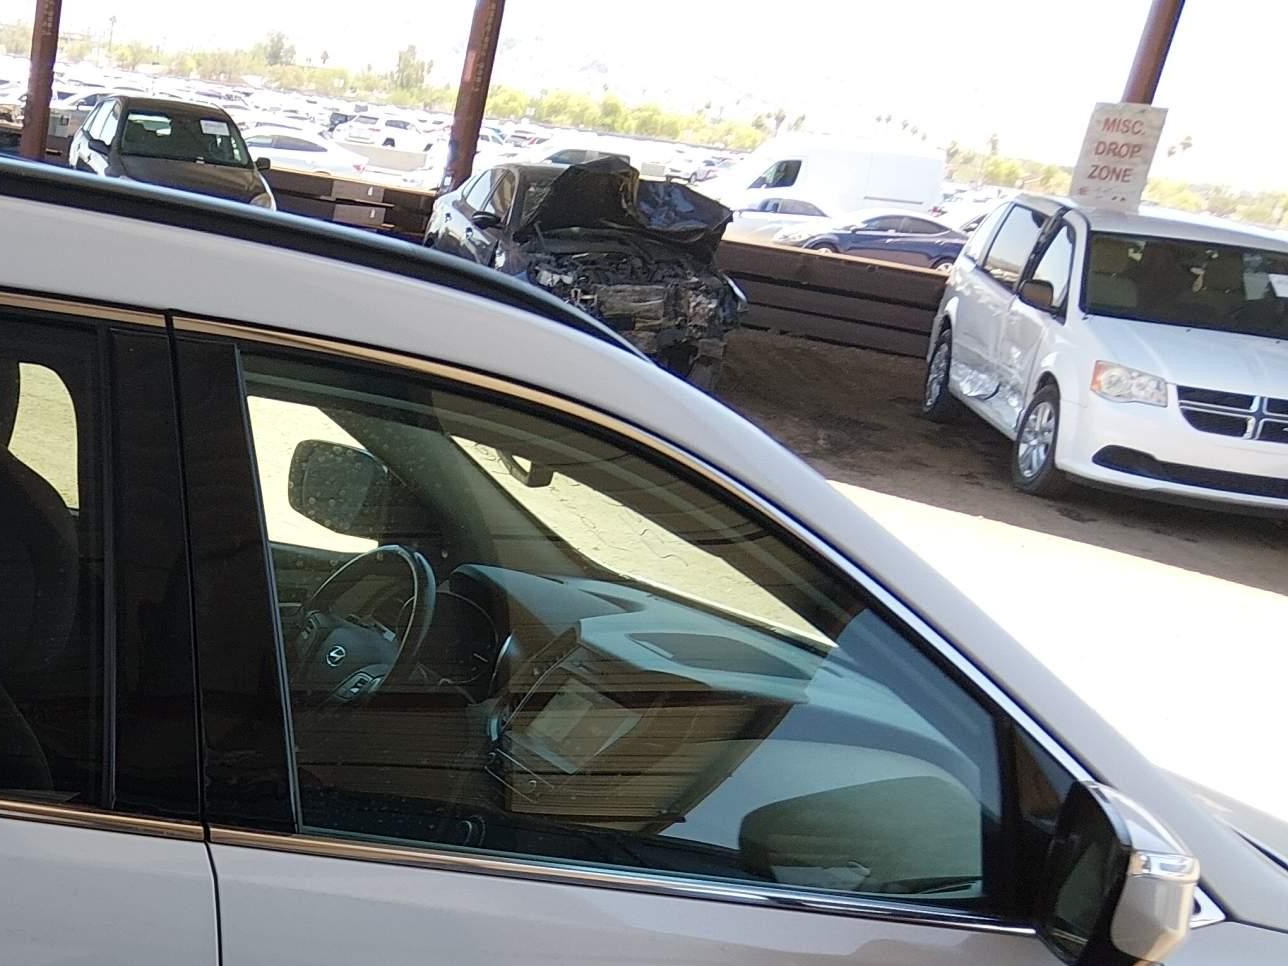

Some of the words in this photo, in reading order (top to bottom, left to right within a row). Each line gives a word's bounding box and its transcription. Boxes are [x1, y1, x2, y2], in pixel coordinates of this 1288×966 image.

[1101, 117, 1146, 136] MISC.
[1094, 140, 1143, 159] DROP
[1087, 164, 1133, 183] ZONE
